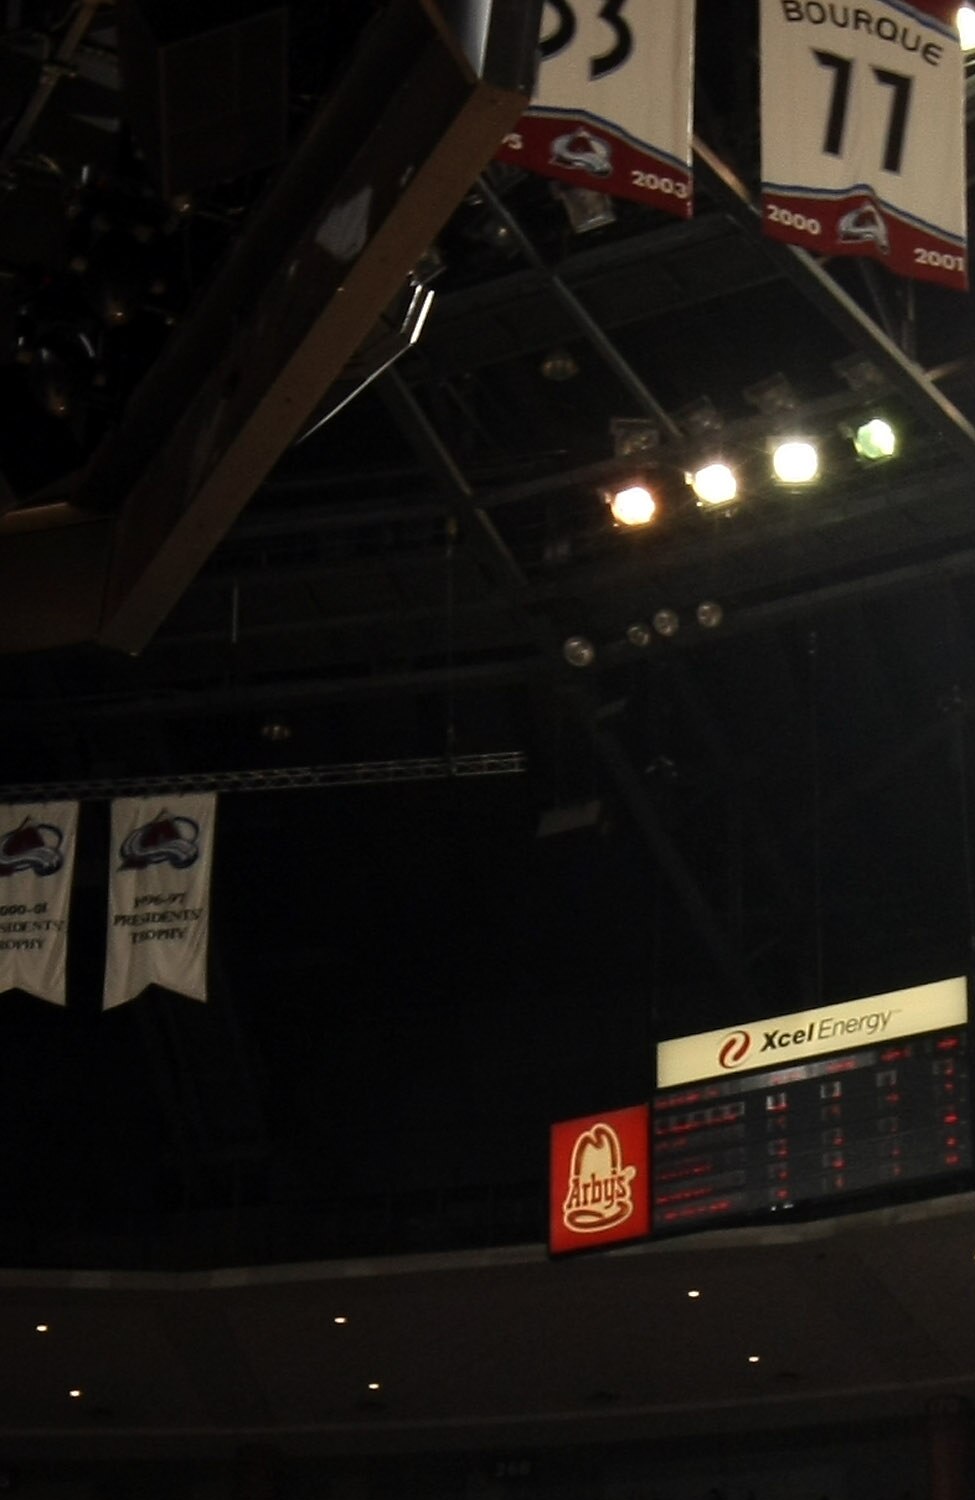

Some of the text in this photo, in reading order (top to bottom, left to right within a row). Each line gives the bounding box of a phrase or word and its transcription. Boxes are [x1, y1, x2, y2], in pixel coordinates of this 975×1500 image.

[783, 0, 943, 66] BOURQUE
[631, 171, 688, 199] 2003
[766, 205, 821, 235] 2000
[913, 249, 965, 274] 2001
[759, 1008, 893, 1052] Xcel Energy
[567, 1168, 628, 1209] Arby's
